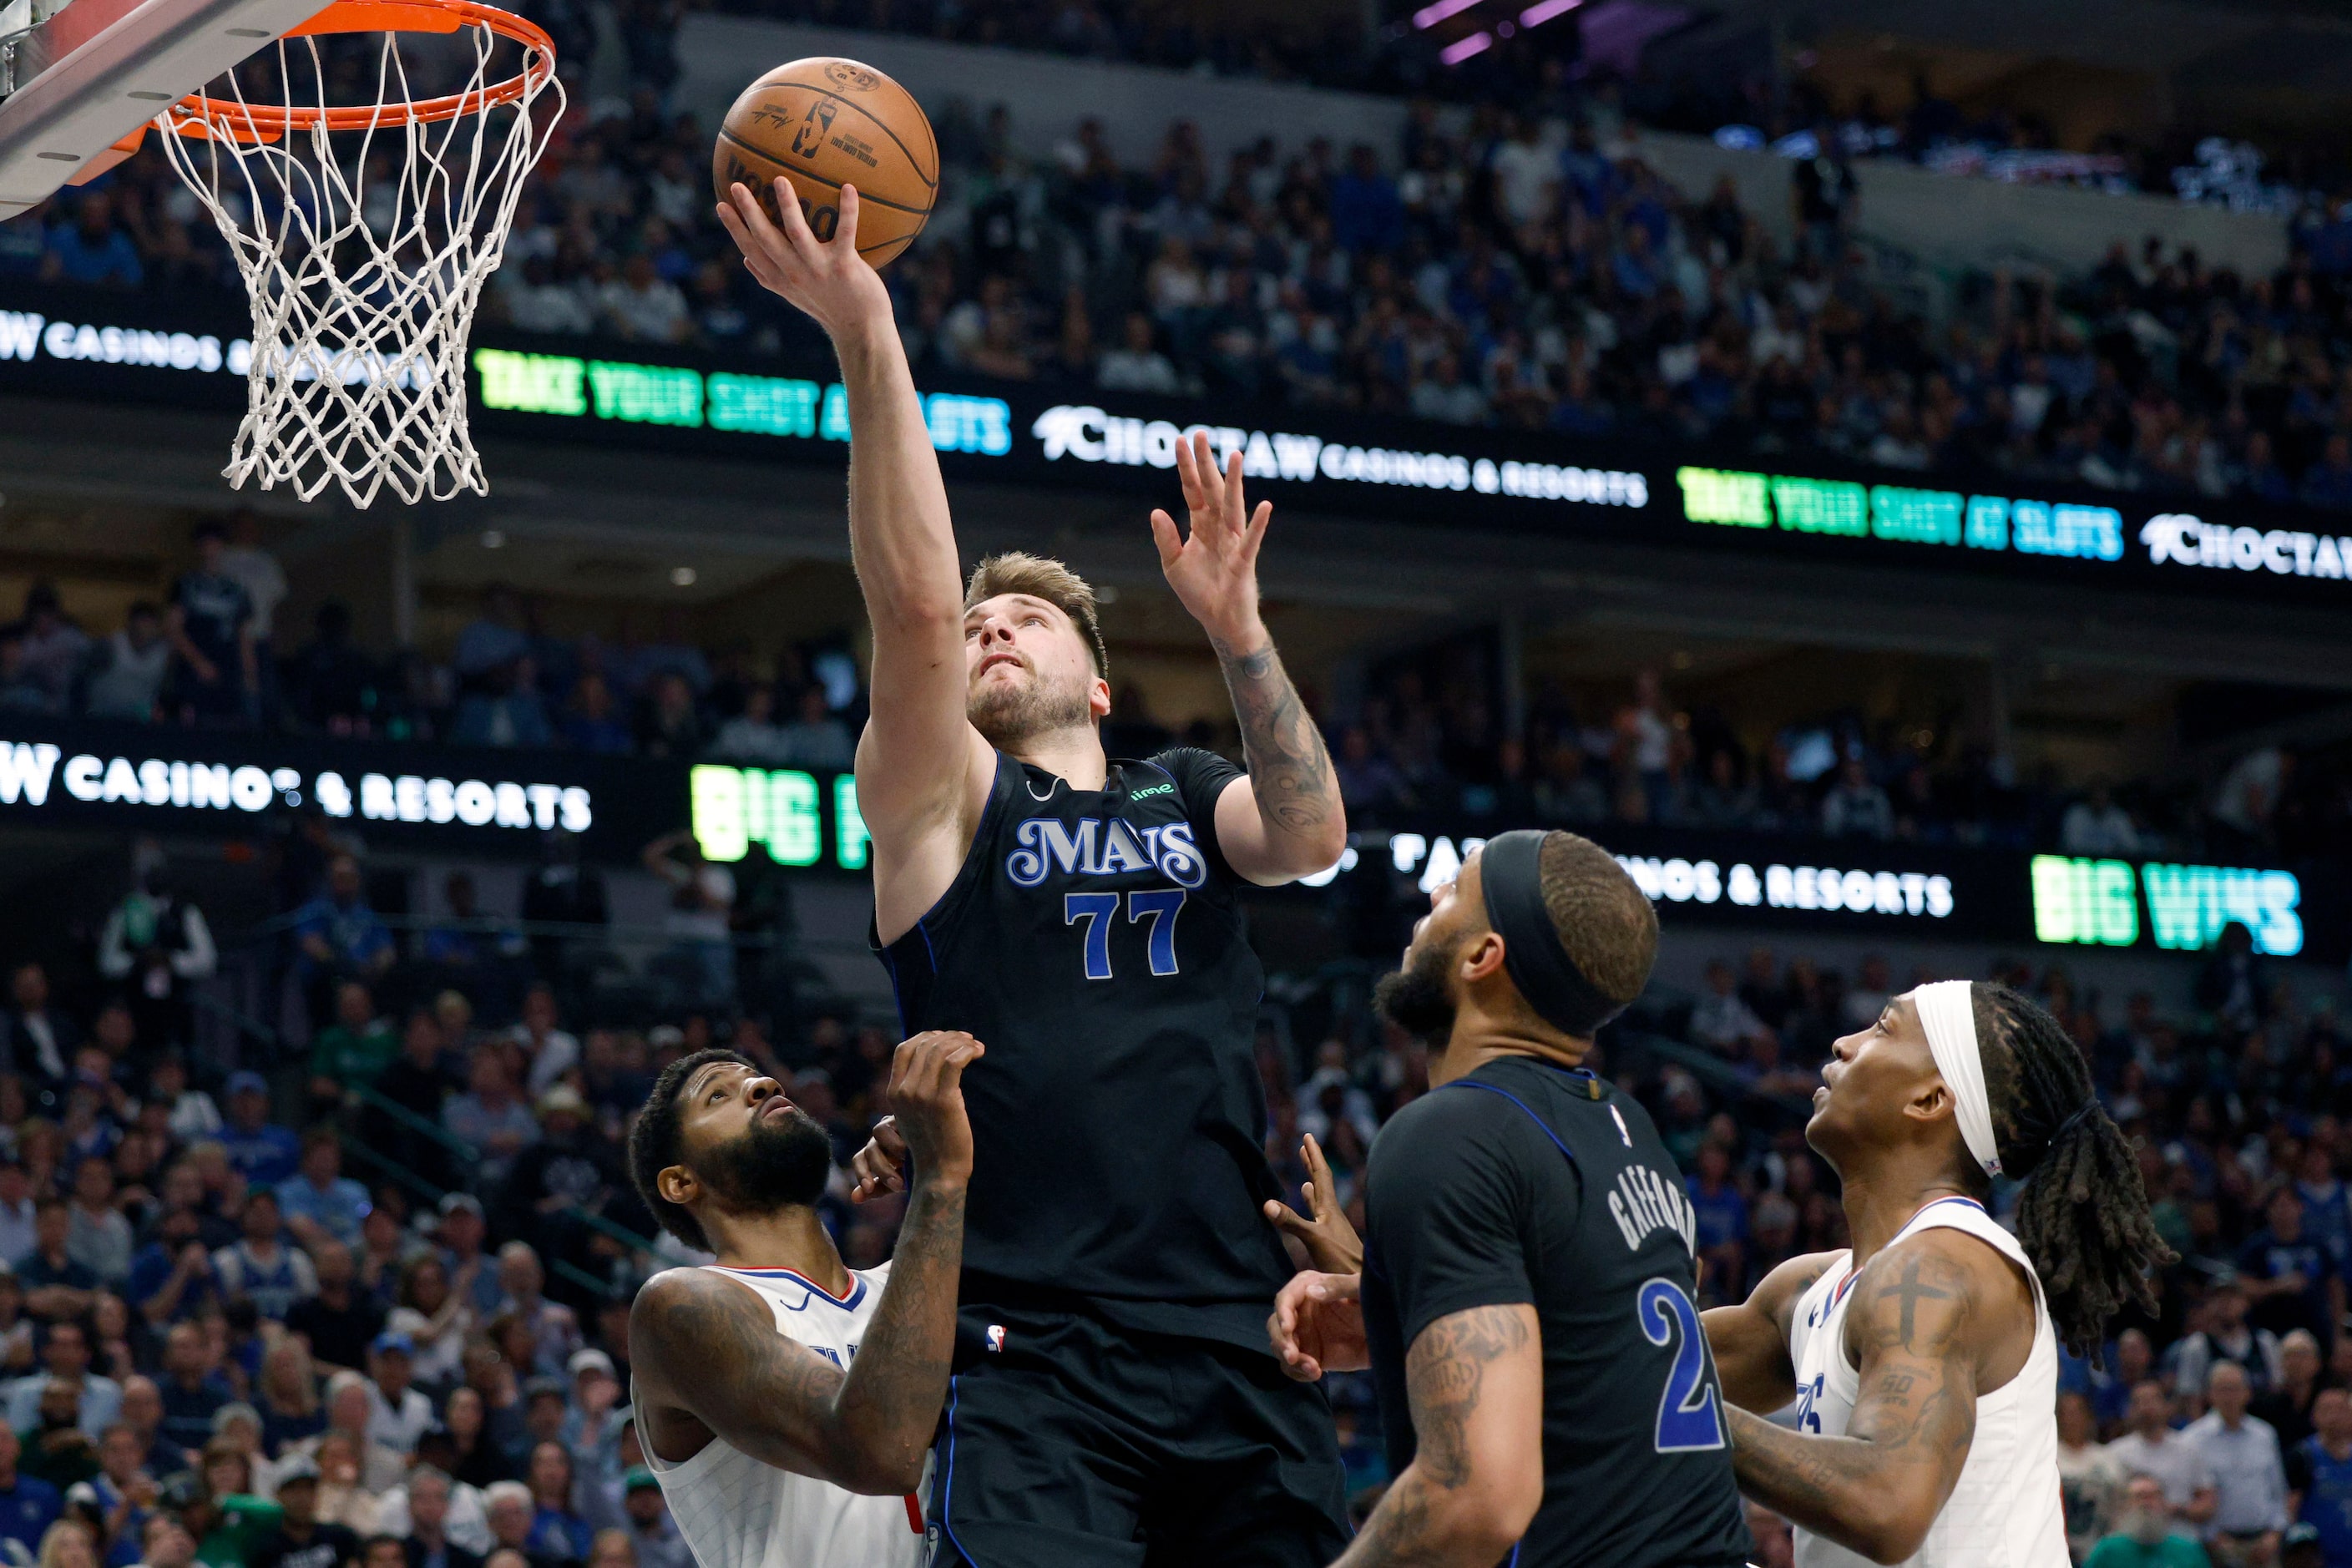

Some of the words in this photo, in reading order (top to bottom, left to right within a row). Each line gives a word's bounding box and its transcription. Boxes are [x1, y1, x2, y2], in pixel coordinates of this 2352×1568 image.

[44, 321, 222, 372] CASINOS
[473, 347, 587, 416] TAKE
[587, 359, 704, 428] YOUR
[706, 372, 821, 439] SHOT
[1319, 443, 1470, 491] CASINOS
[1472, 458, 1500, 494] &
[1500, 461, 1649, 508] RESORTS
[1676, 465, 1773, 529] TAKE
[1770, 474, 1869, 538] YOUR
[2169, 513, 2352, 580] CHOCTA
[316, 771, 352, 817] &
[361, 773, 591, 832] RESORTS
[690, 763, 822, 867] BIG
[1727, 863, 1763, 907] &
[1765, 864, 1954, 918] RESORTS
[2031, 854, 2139, 947] BIG
[1065, 888, 1186, 979] 77
